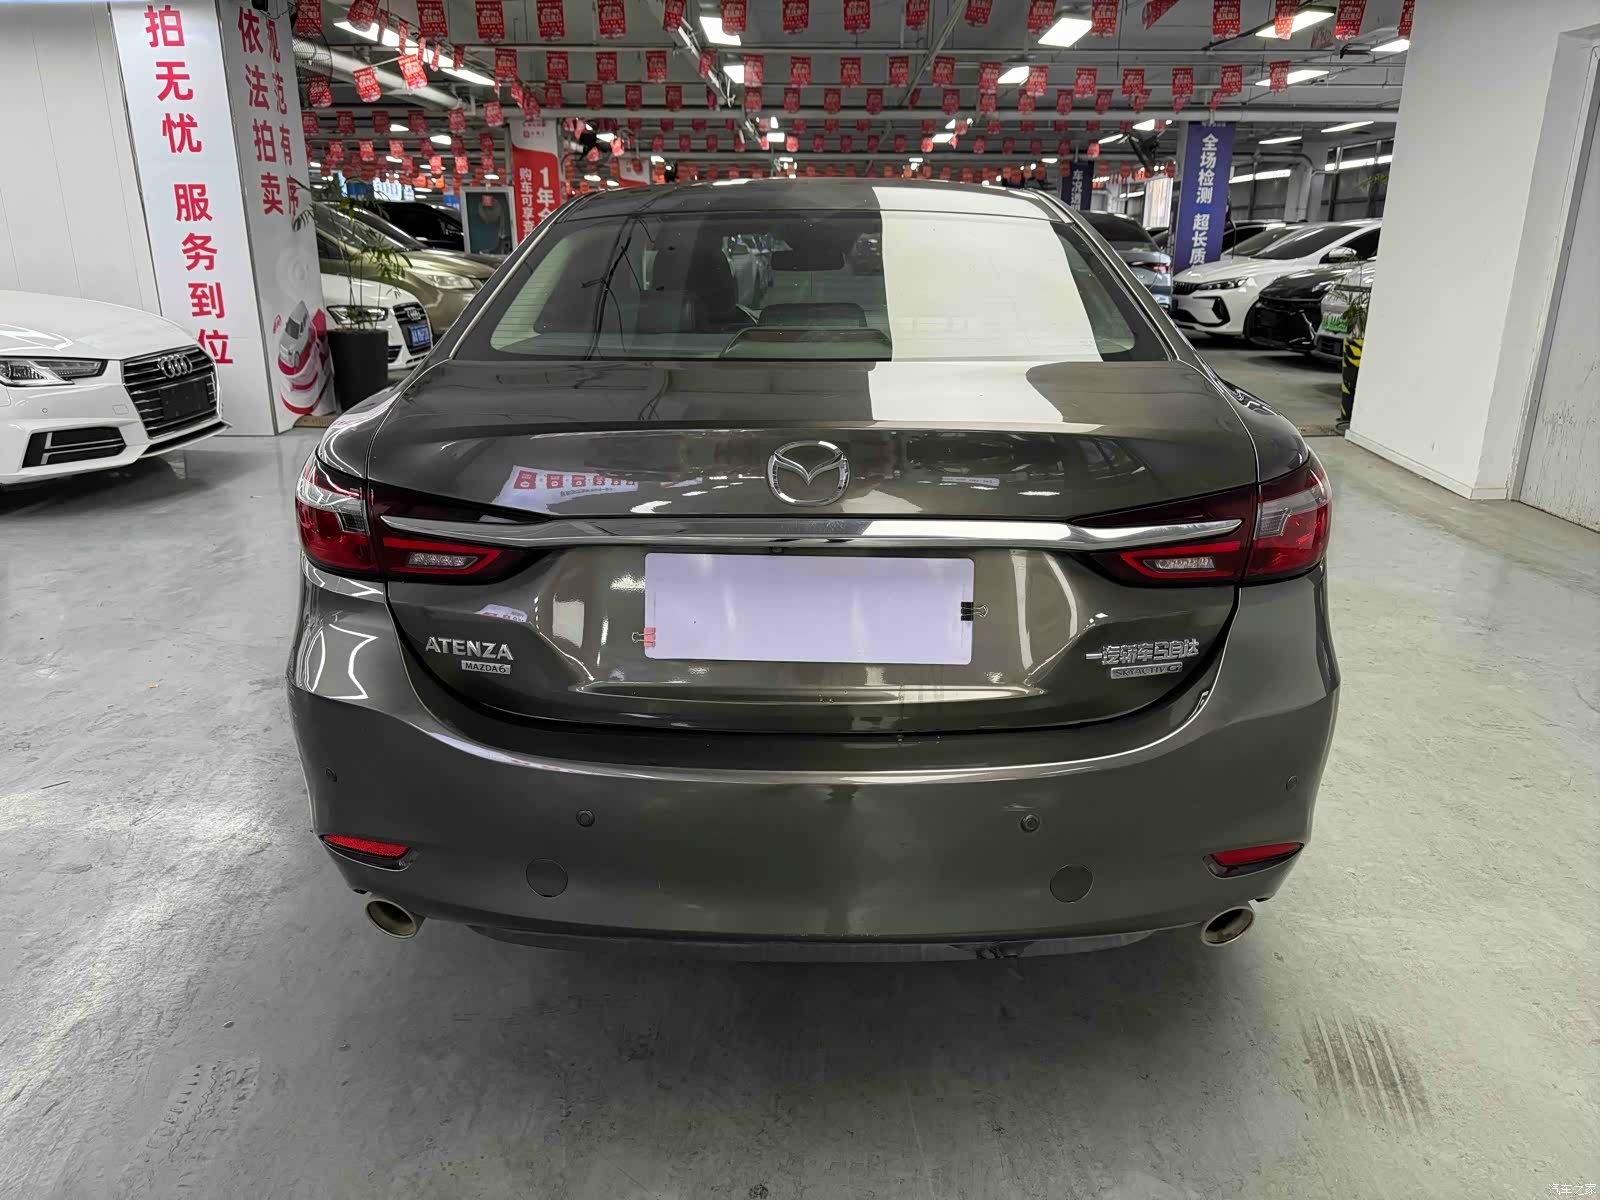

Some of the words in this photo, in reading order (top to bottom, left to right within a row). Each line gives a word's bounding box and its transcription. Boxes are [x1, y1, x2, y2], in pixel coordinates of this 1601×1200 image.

[237, 6, 284, 215] 依法拍卖
[266, 18, 299, 216] 规范有序
[144, 4, 202, 154] 拍无忧
[173, 183, 233, 364] 服务到位
[1196, 133, 1219, 205] 全场检测
[425, 636, 514, 660] ATENZA
[465, 662, 506, 674] MAZDA6
[1086, 638, 1200, 666] 一汽轿车马自达
